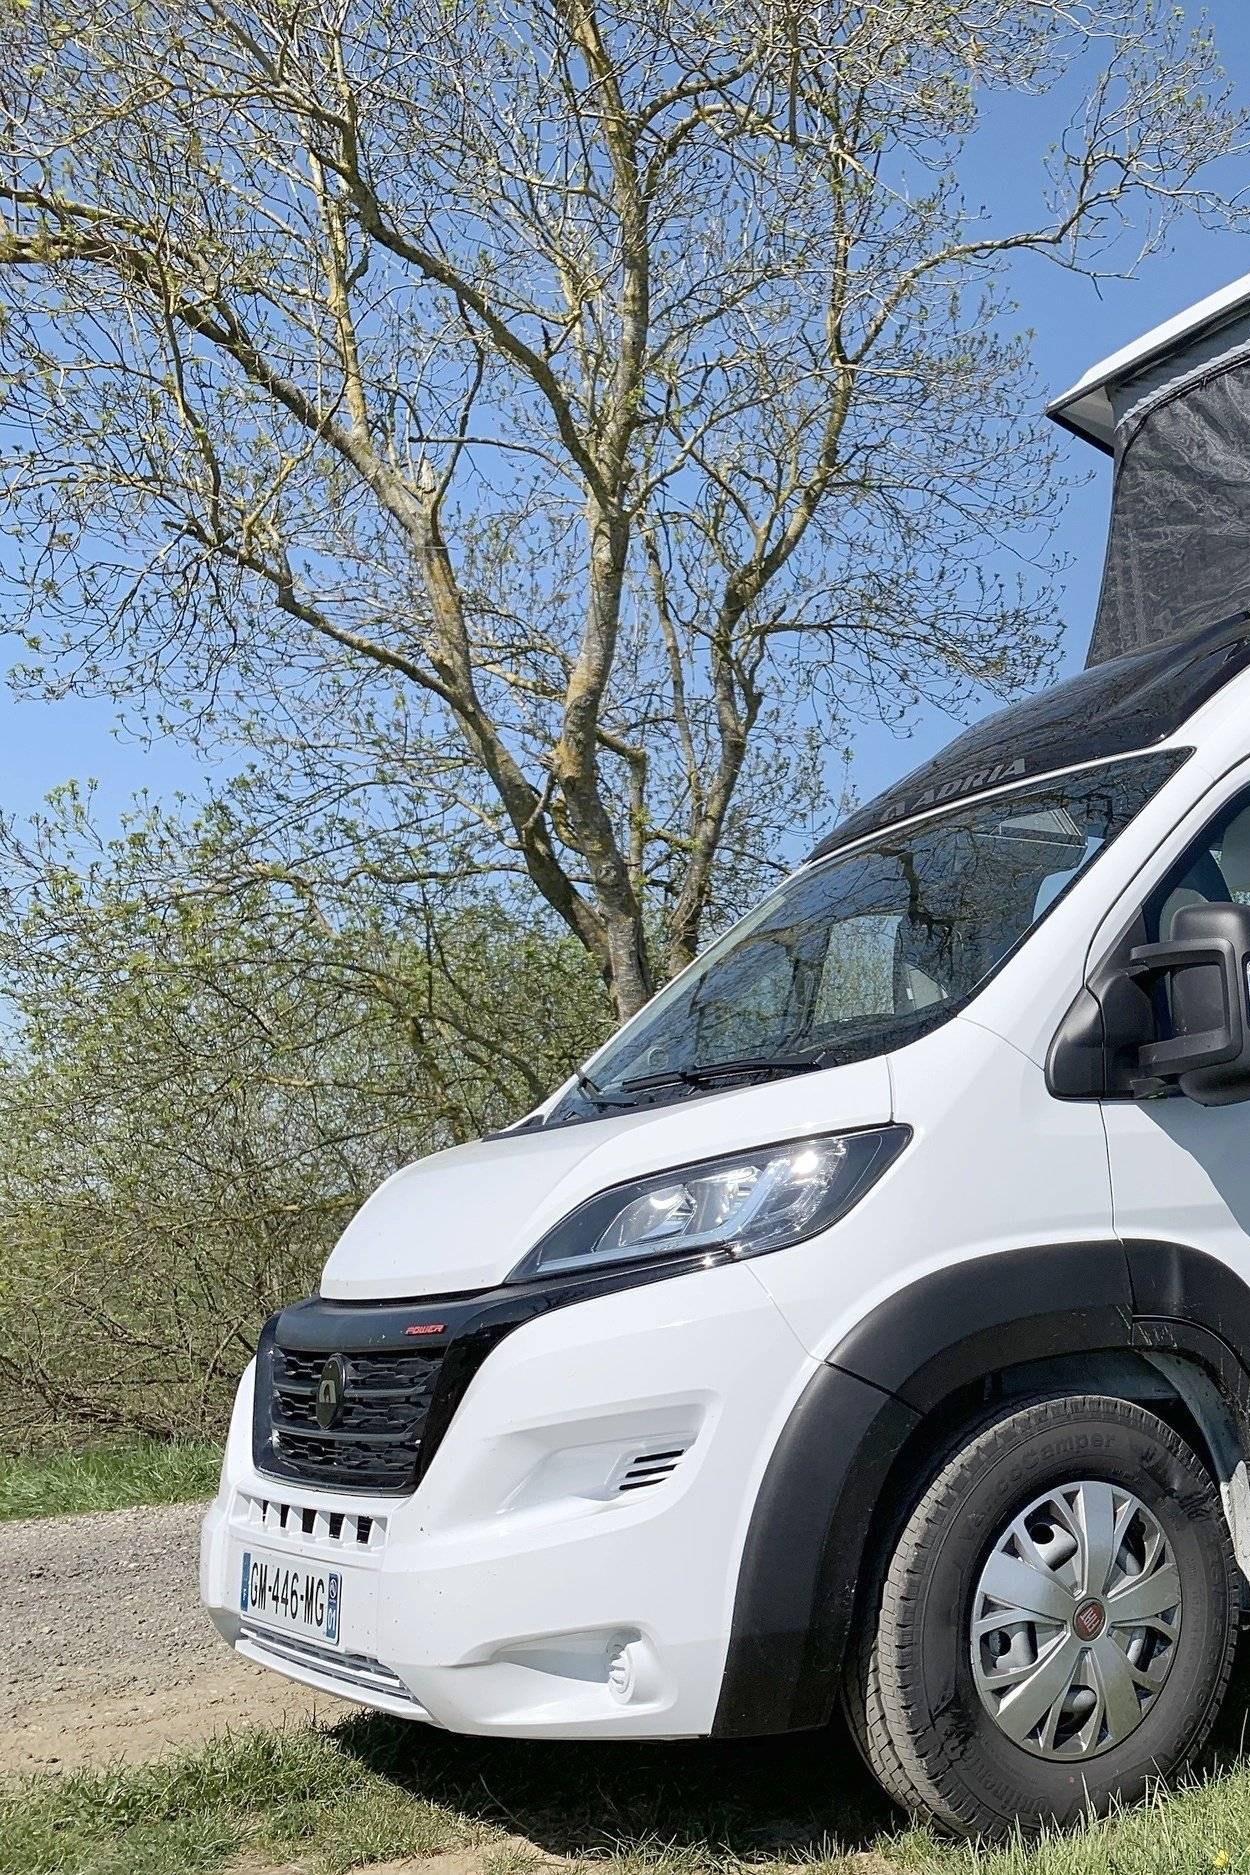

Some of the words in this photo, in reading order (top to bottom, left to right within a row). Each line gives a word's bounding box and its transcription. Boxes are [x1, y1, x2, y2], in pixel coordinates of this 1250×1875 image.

[911, 758, 1026, 810] ADRIA
[404, 1323, 446, 1335] POWER
[250, 1562, 325, 1627] GM-446-MG
